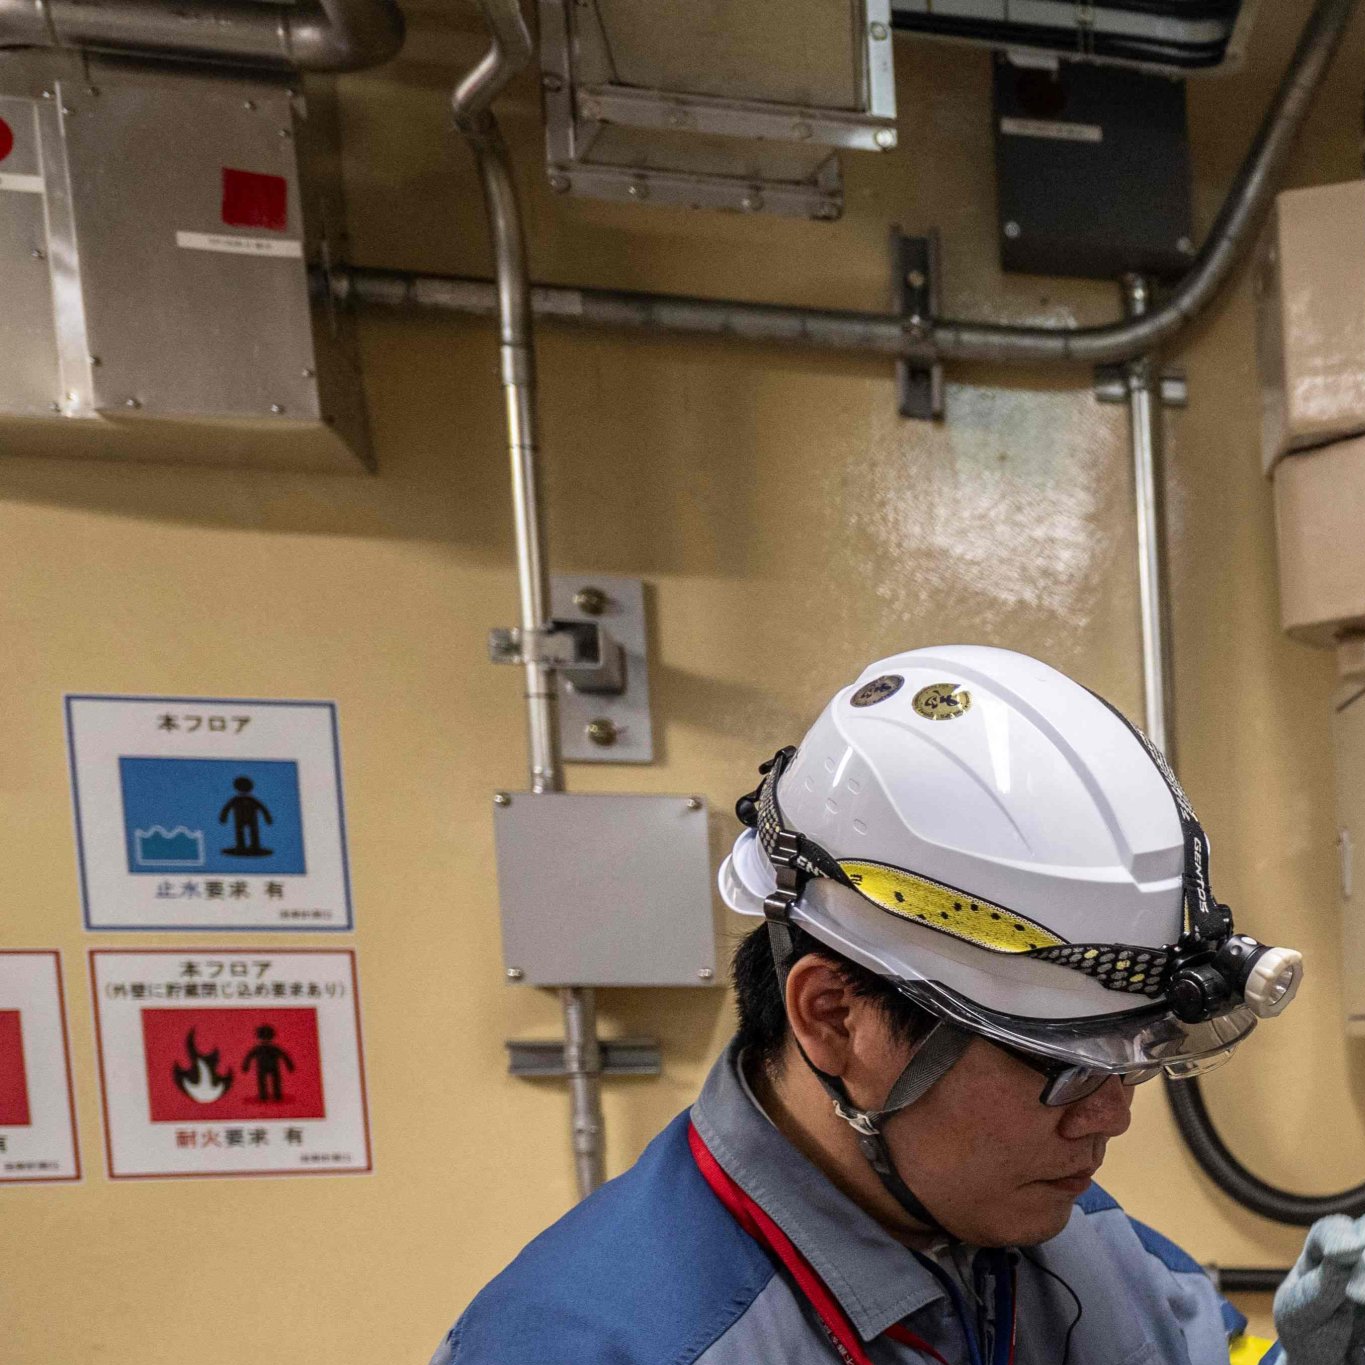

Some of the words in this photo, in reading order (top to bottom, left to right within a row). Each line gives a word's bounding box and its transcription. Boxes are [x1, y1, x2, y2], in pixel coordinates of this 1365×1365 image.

[158, 712, 251, 734] 本フロア
[1193, 836, 1209, 913] GENTOS
[156, 880, 250, 899] 止水要求
[264, 880, 284, 900] 有
[180, 959, 273, 979] 本フロア
[175, 1129, 270, 1149] 耐火要求
[284, 1127, 304, 1147] 有
